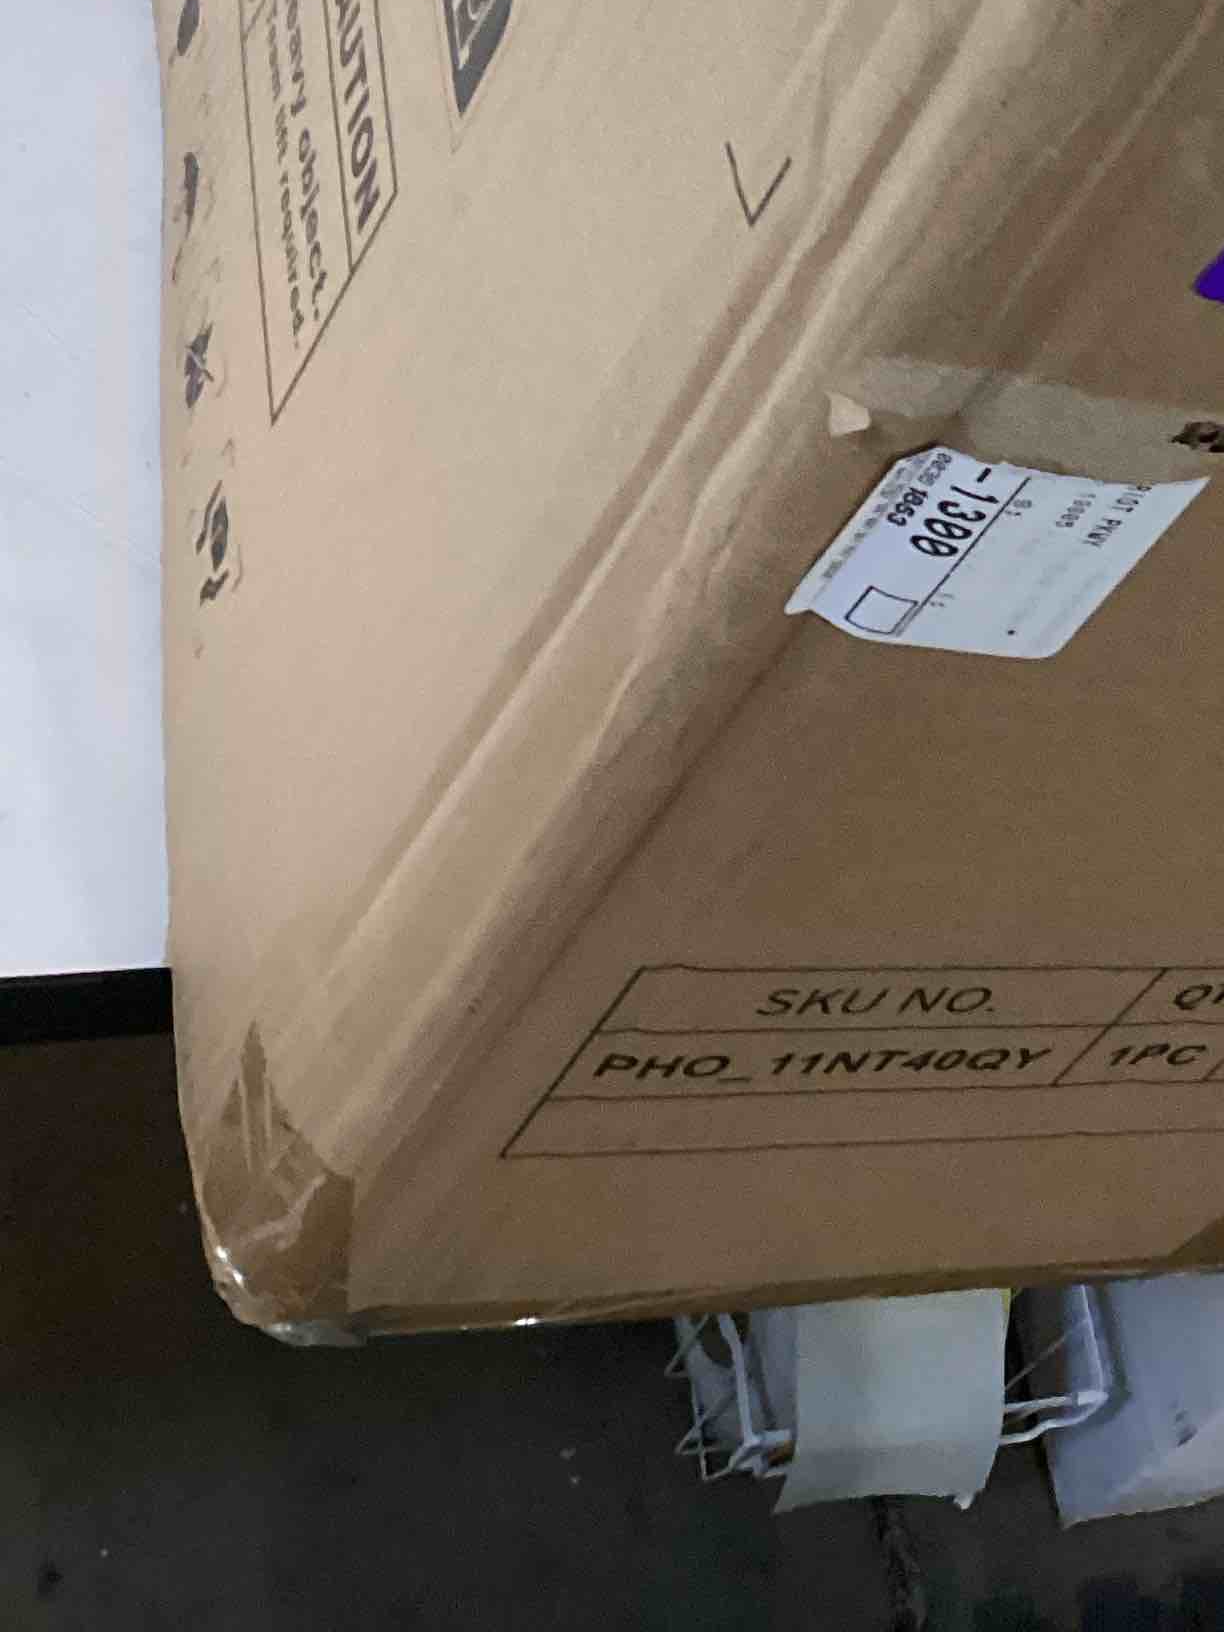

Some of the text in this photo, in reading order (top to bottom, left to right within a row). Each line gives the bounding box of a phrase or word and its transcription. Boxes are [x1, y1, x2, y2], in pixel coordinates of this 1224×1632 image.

[756, 985, 1001, 1017] SKU NO.
[1107, 1043, 1209, 1068] 1PC
